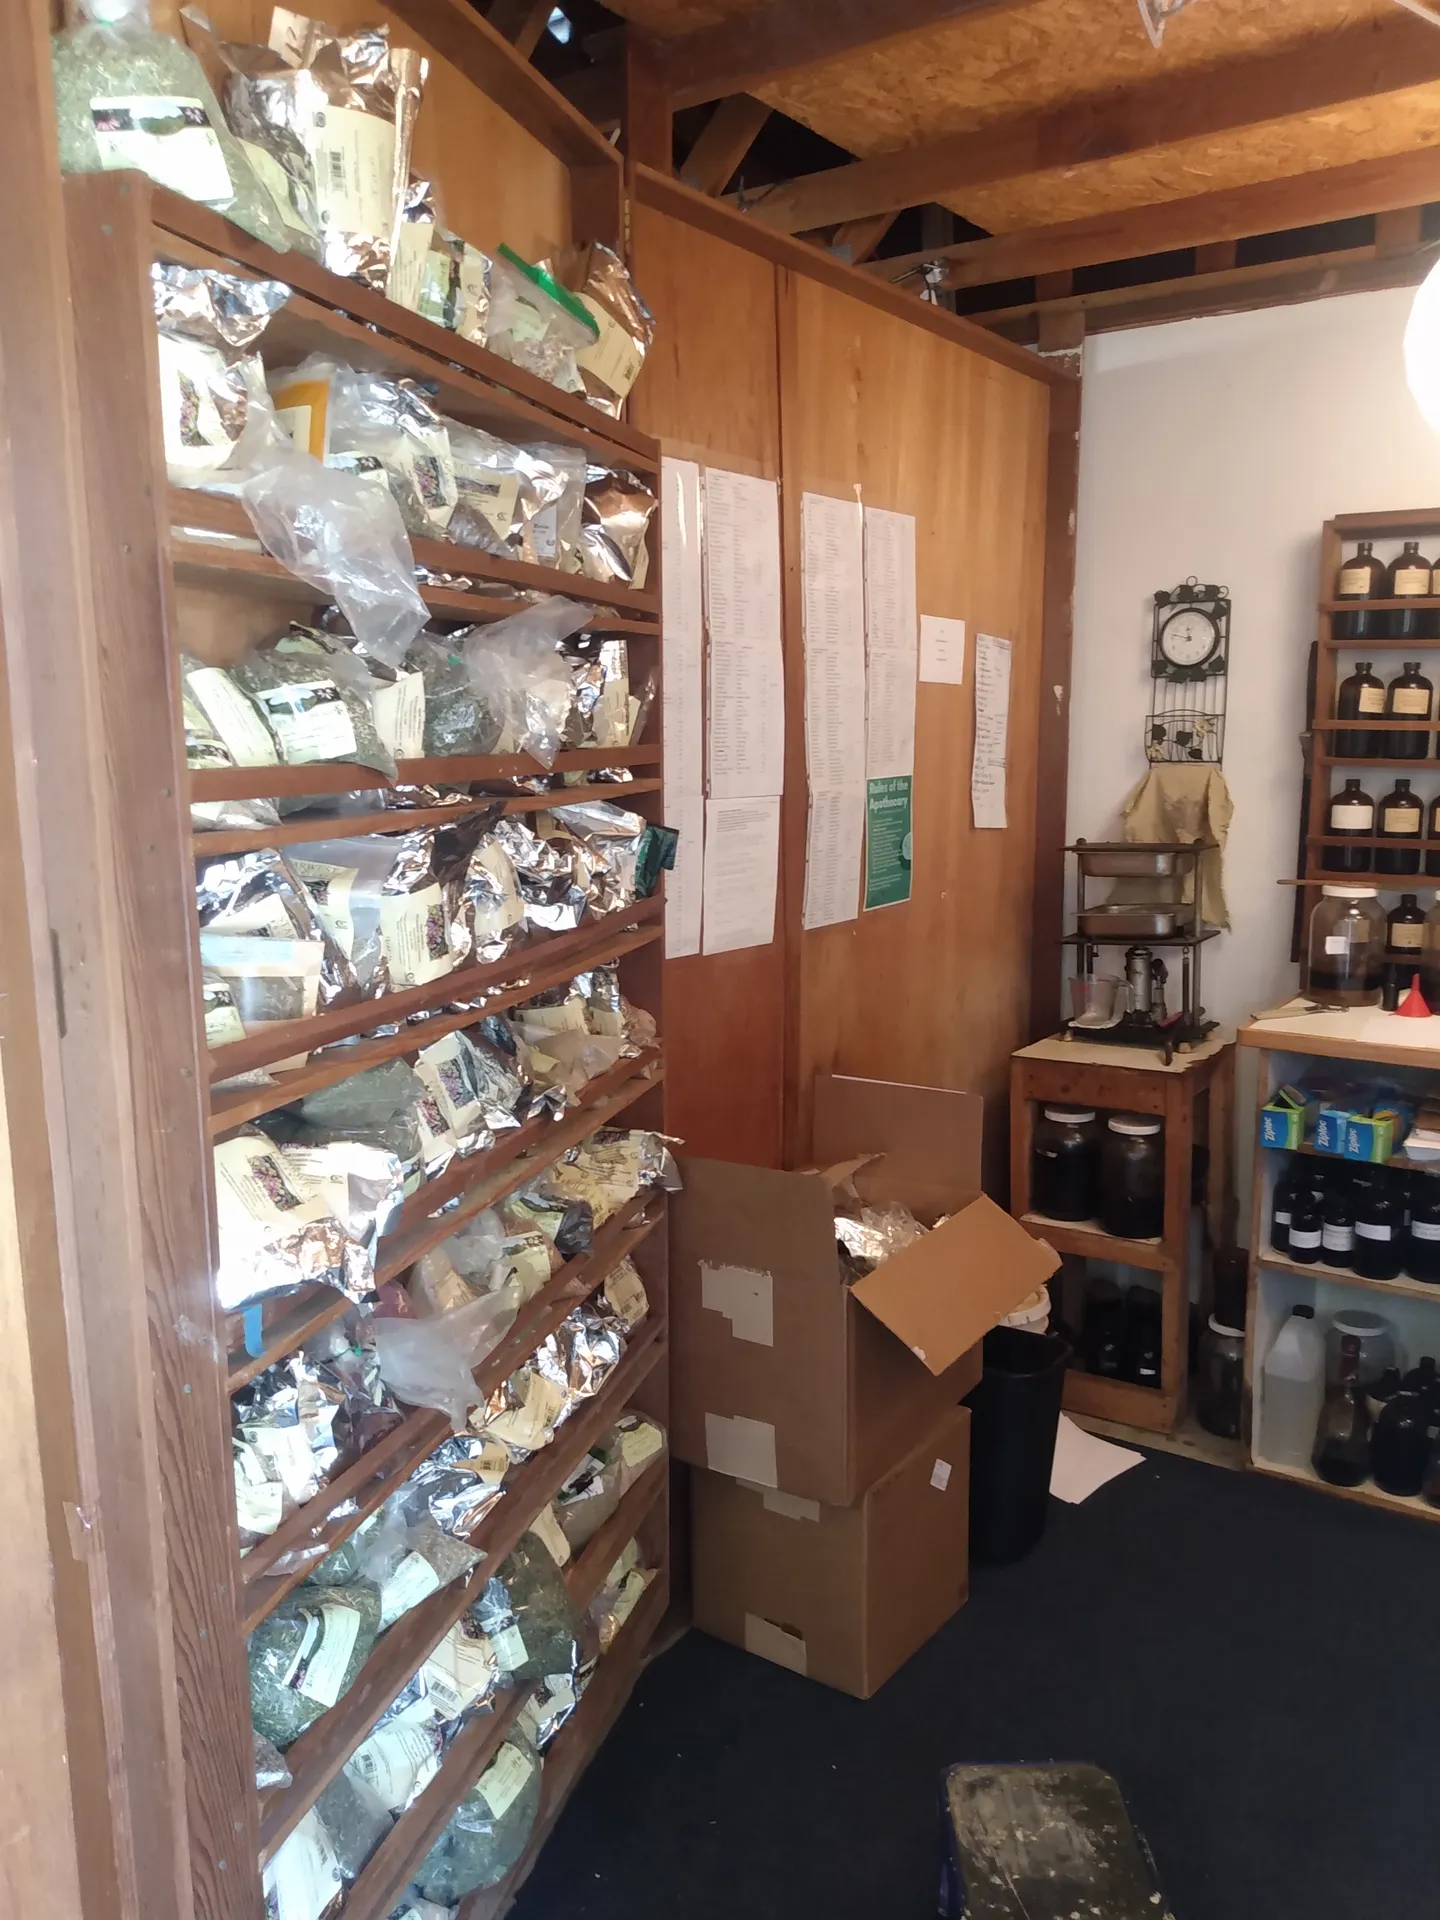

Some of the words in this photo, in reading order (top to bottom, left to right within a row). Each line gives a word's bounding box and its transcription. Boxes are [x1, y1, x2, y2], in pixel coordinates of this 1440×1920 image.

[869, 780, 888, 794] Rules
[889, 779, 897, 792] of
[897, 778, 908, 791] the
[869, 795, 908, 814] Apothecary
[1264, 1116, 1275, 1142] Ziploc
[1318, 1120, 1330, 1147] Ziploc
[1348, 1128, 1360, 1154] Ziploc
